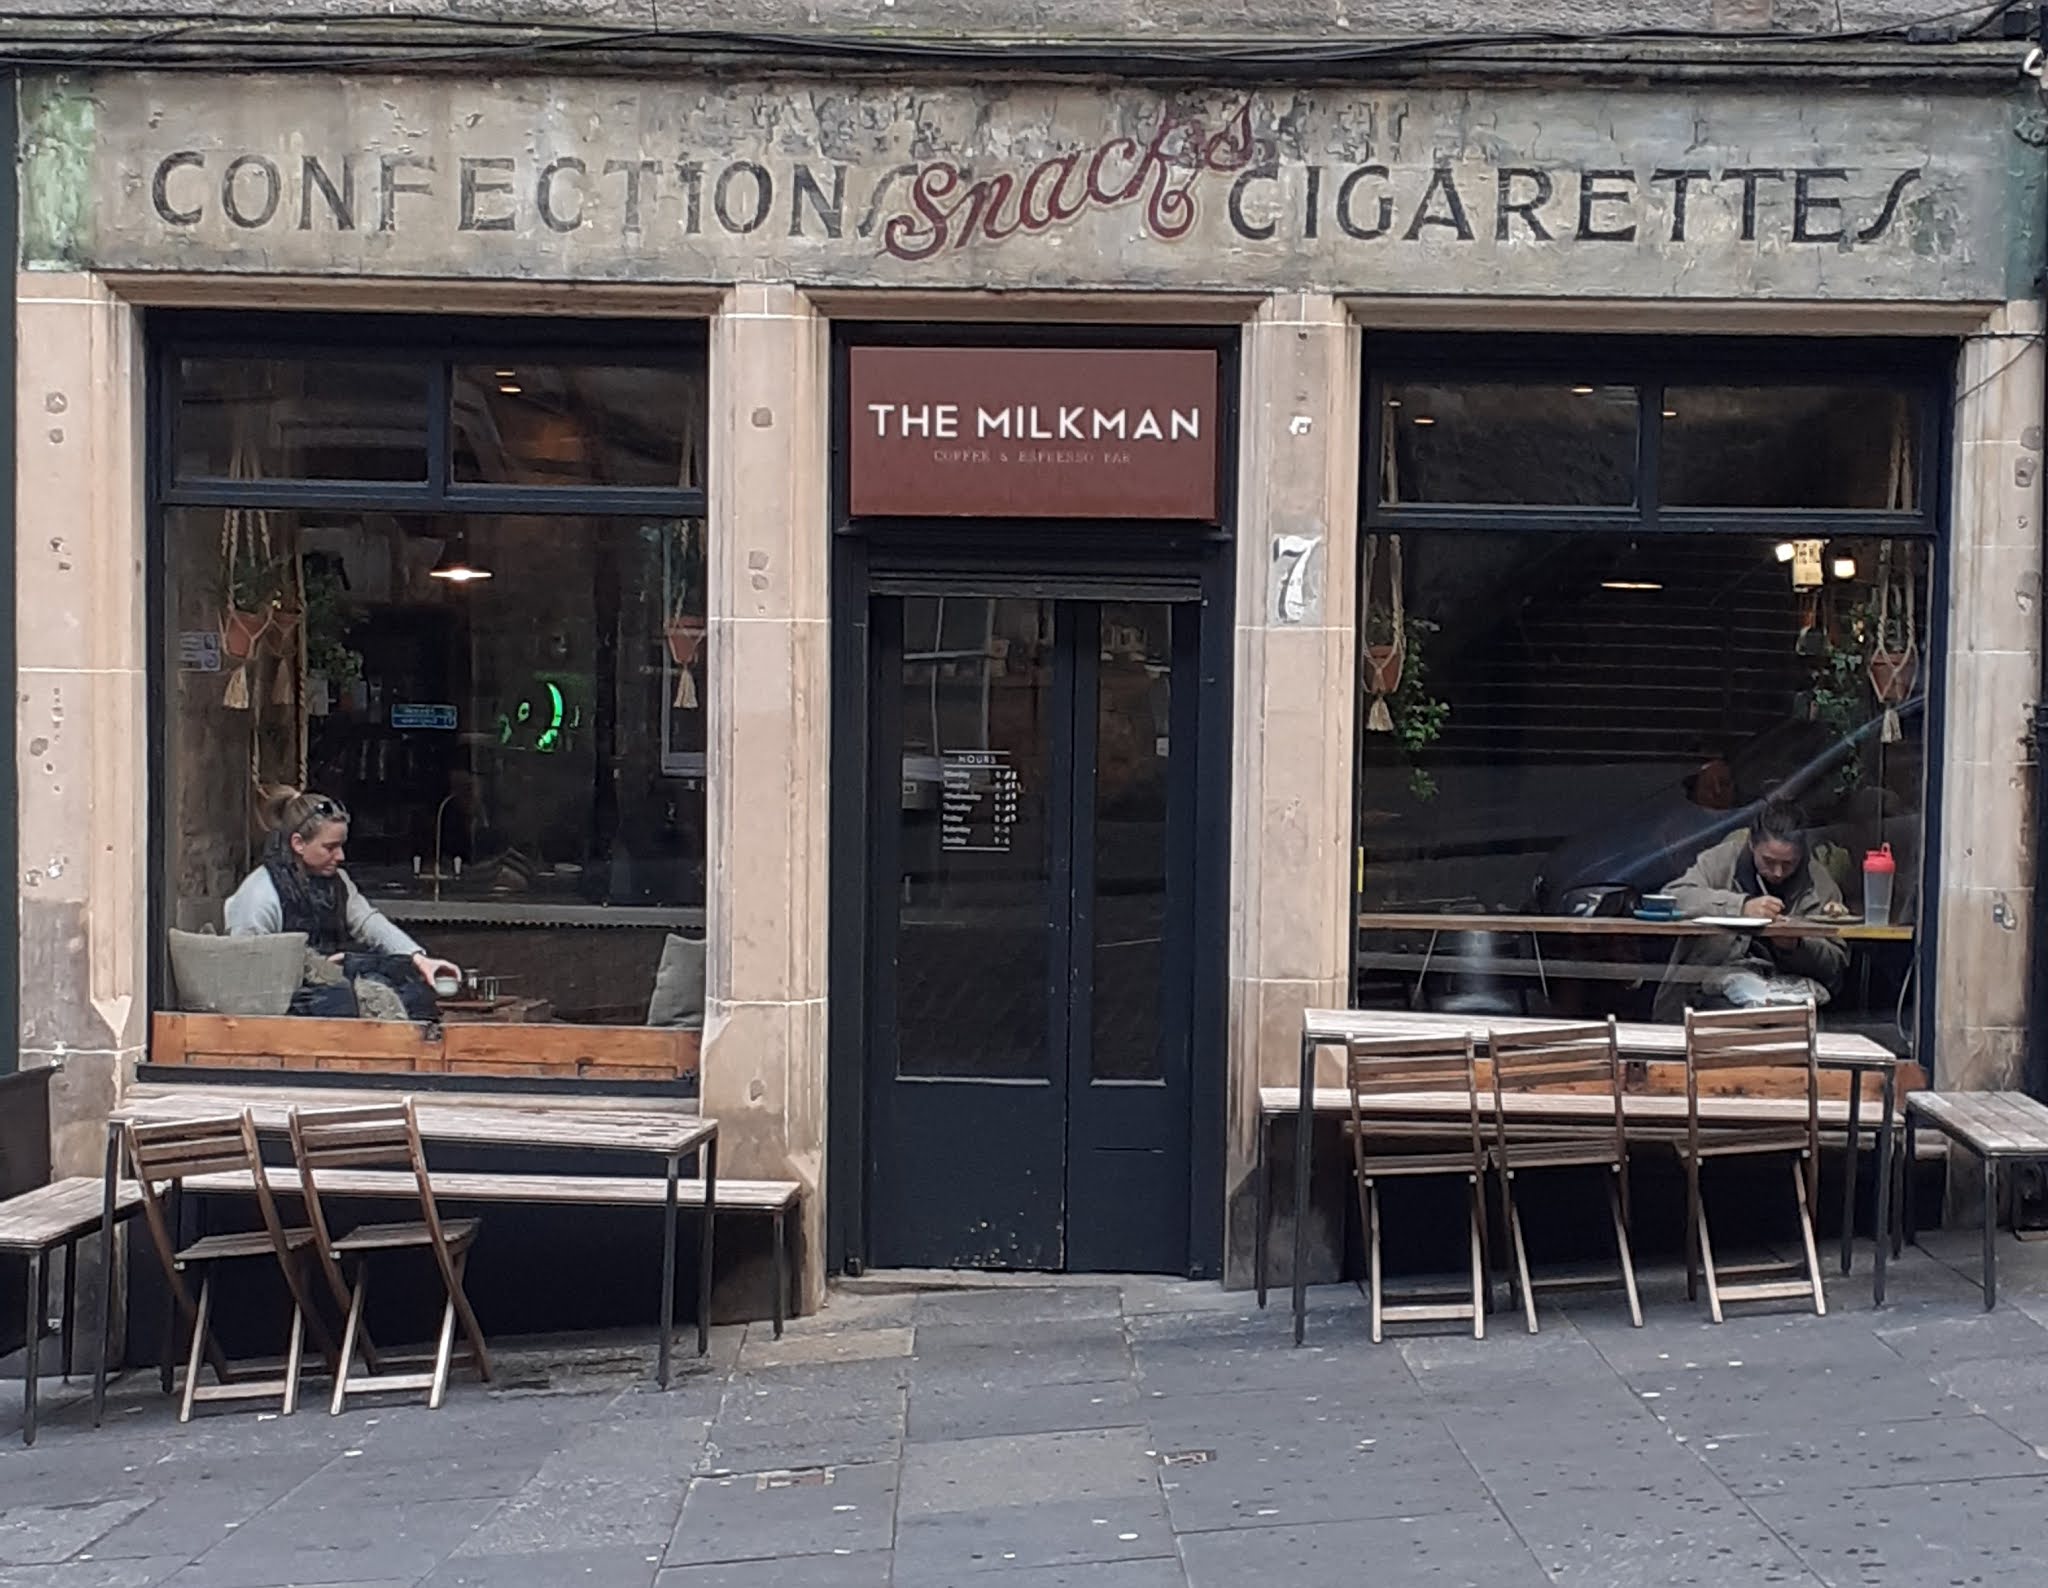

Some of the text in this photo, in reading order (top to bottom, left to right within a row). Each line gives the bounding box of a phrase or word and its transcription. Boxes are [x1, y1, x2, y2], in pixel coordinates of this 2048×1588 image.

[875, 92, 1256, 261] Snacks
[1228, 163, 1922, 243] CIGARETTES
[867, 403, 1200, 441] THE MILKMAN
[1273, 535, 1322, 623] 7
[958, 754, 997, 765] HOURS
